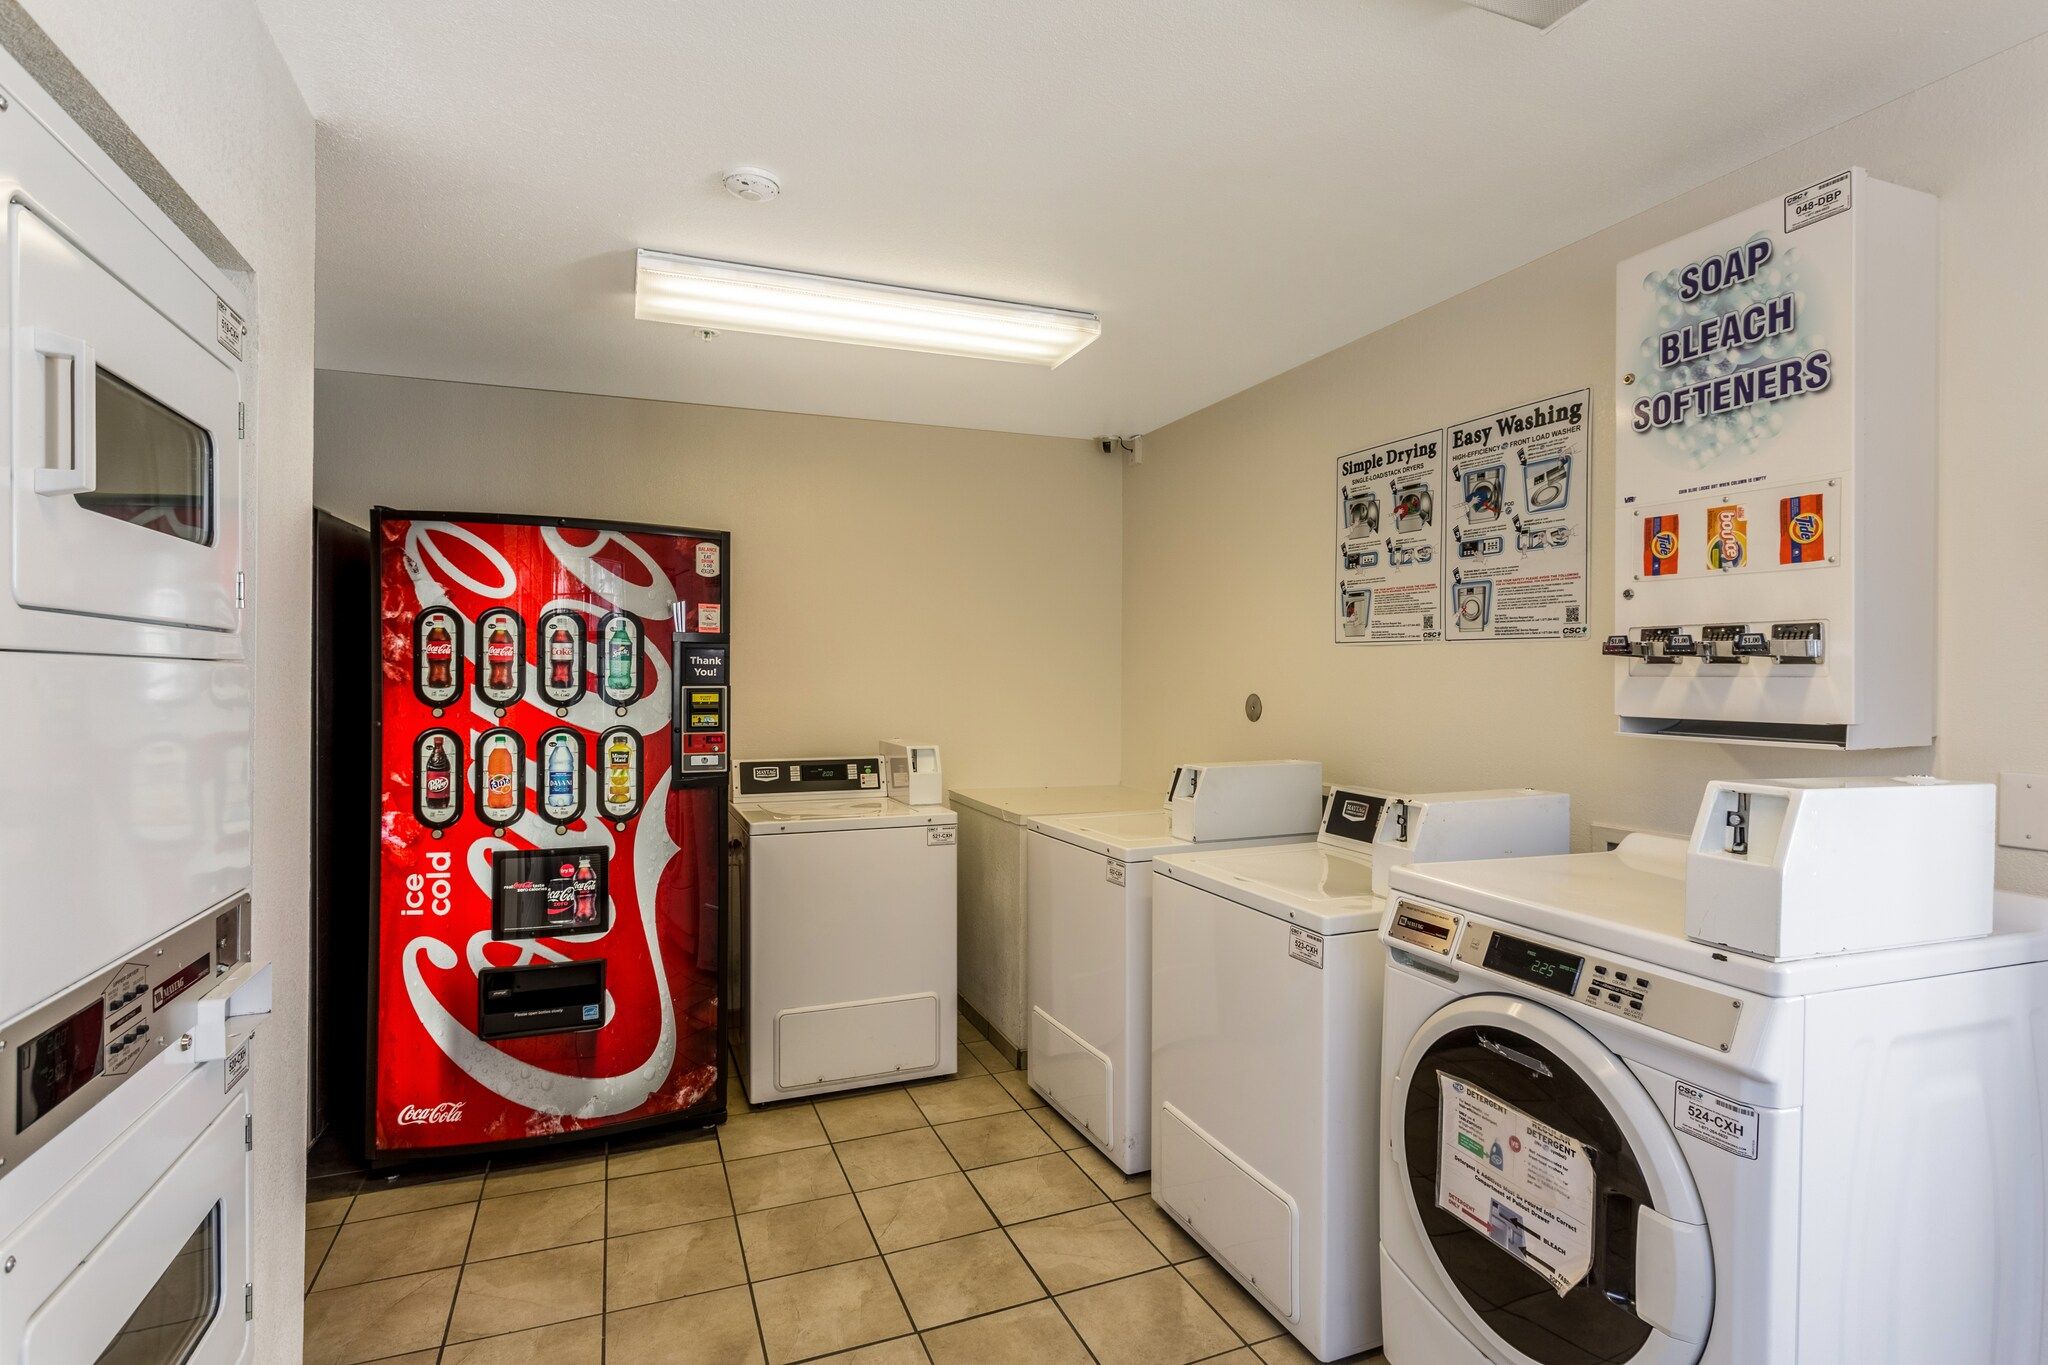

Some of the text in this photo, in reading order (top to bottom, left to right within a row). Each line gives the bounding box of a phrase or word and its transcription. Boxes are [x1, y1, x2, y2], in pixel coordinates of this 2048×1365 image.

[1795, 190, 1842, 215] 048-DBP
[1679, 239, 1772, 302] SOAP
[1660, 295, 1793, 367] BLEACH
[1633, 352, 1830, 431] SOFTENERS
[1452, 403, 1583, 449] Easy Washing
[1452, 444, 1501, 461] HIGH-EFFICIENCY
[1509, 436, 1530, 447] FRONT
[1531, 432, 1550, 443] LOAD
[1551, 424, 1582, 437] WASHER
[1341, 453, 1383, 476] Simple
[1386, 442, 1438, 465] Drying
[1351, 467, 1401, 485] SINGLE-LOAD/STACK
[1402, 462, 1425, 473] DRYERS
[1795, 515, 1815, 540] Tide
[1656, 534, 1673, 556] Tide
[426, 644, 452, 654] Coca-Cola
[488, 645, 514, 656] Coca-Cola
[552, 647, 573, 656] Coke
[1611, 637, 1625, 645] $1.00
[1743, 636, 1761, 644] $1.00
[690, 656, 722, 665] Thank
[693, 668, 717, 676] You!
[489, 777, 511, 789] Fanta
[400, 873, 425, 916] ice
[425, 851, 452, 916] cold
[1294, 939, 1319, 955] 523-CXH
[1530, 959, 1556, 978] 2.25
[1466, 1088, 1507, 1115] DETERGENT
[1677, 1085, 1697, 1097] CSC
[397, 1101, 467, 1126] Coca-Cola
[1687, 1105, 1744, 1137] 524-CXH
[1526, 1126, 1577, 1158] DETERGENT
[1448, 1192, 1476, 1213] DETERGENT
[1448, 1198, 1460, 1209] ONLY
[1454, 1155, 1476, 1172] Detergent
[1481, 1172, 1502, 1189] Additives
[1524, 1198, 1543, 1213] Poured
[1543, 1207, 1556, 1220] Into
[1556, 1215, 1578, 1233] Correct
[1474, 1174, 1506, 1198] Compartment
[1512, 1198, 1531, 1214] Pullout
[1531, 1210, 1550, 1225] Drawer
[1543, 1237, 1566, 1256] BLEACH
